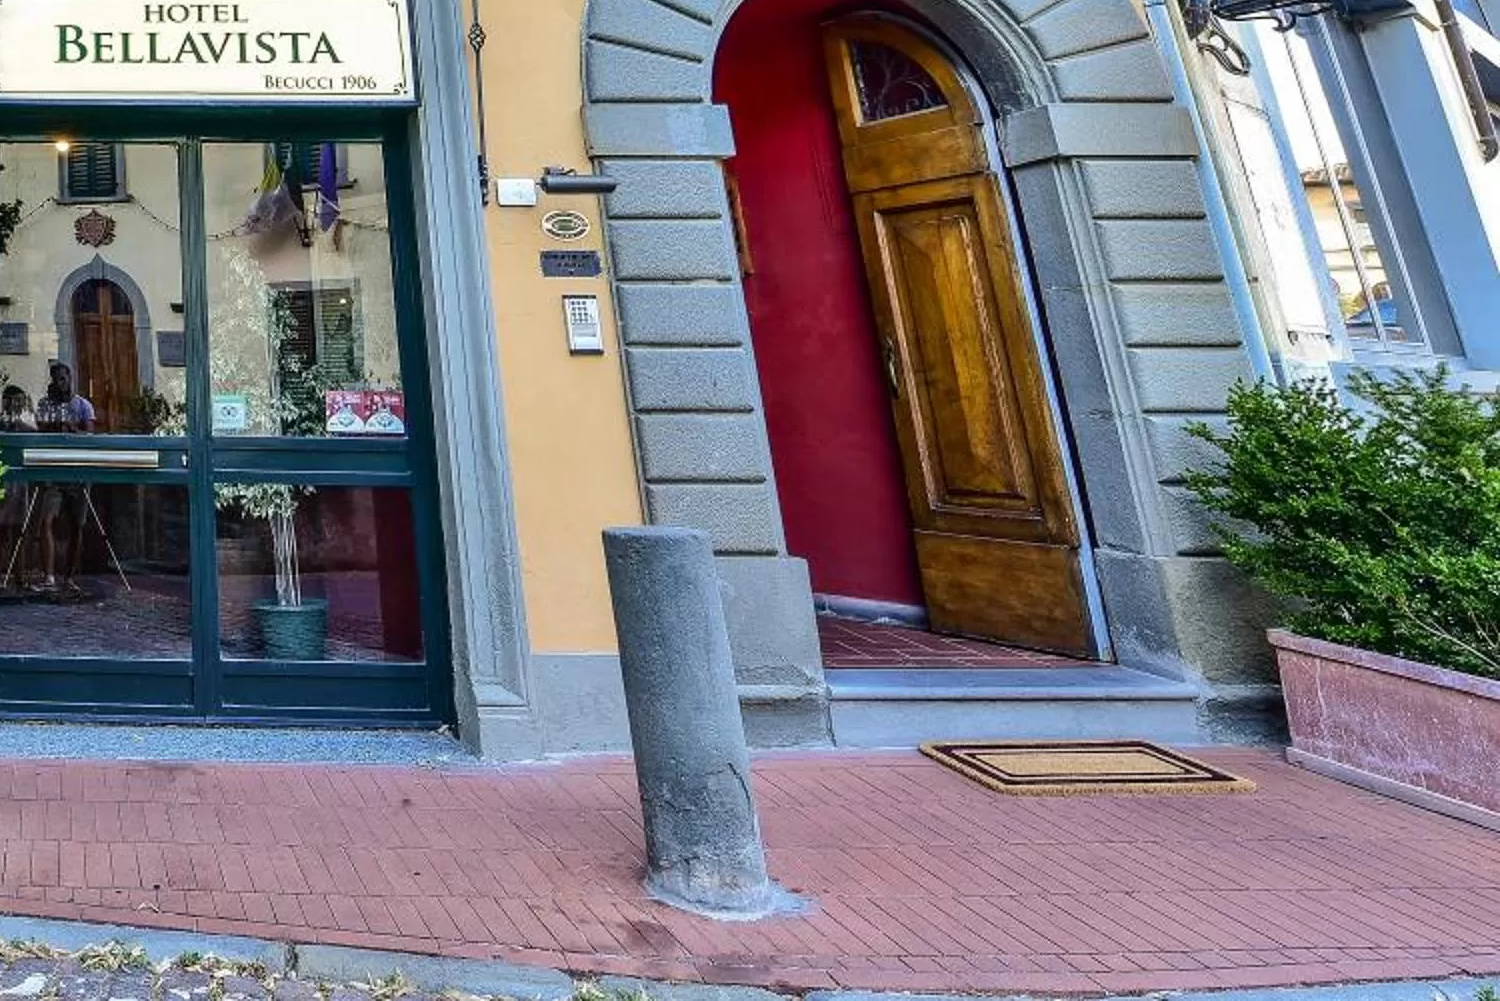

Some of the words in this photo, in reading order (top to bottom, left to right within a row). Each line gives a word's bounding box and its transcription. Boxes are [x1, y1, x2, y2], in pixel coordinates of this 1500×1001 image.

[143, 4, 249, 23] HOTEL
[54, 24, 345, 64] BELLAVISTA
[263, 74, 334, 90] BECUCCI
[341, 75, 377, 90] 1906
